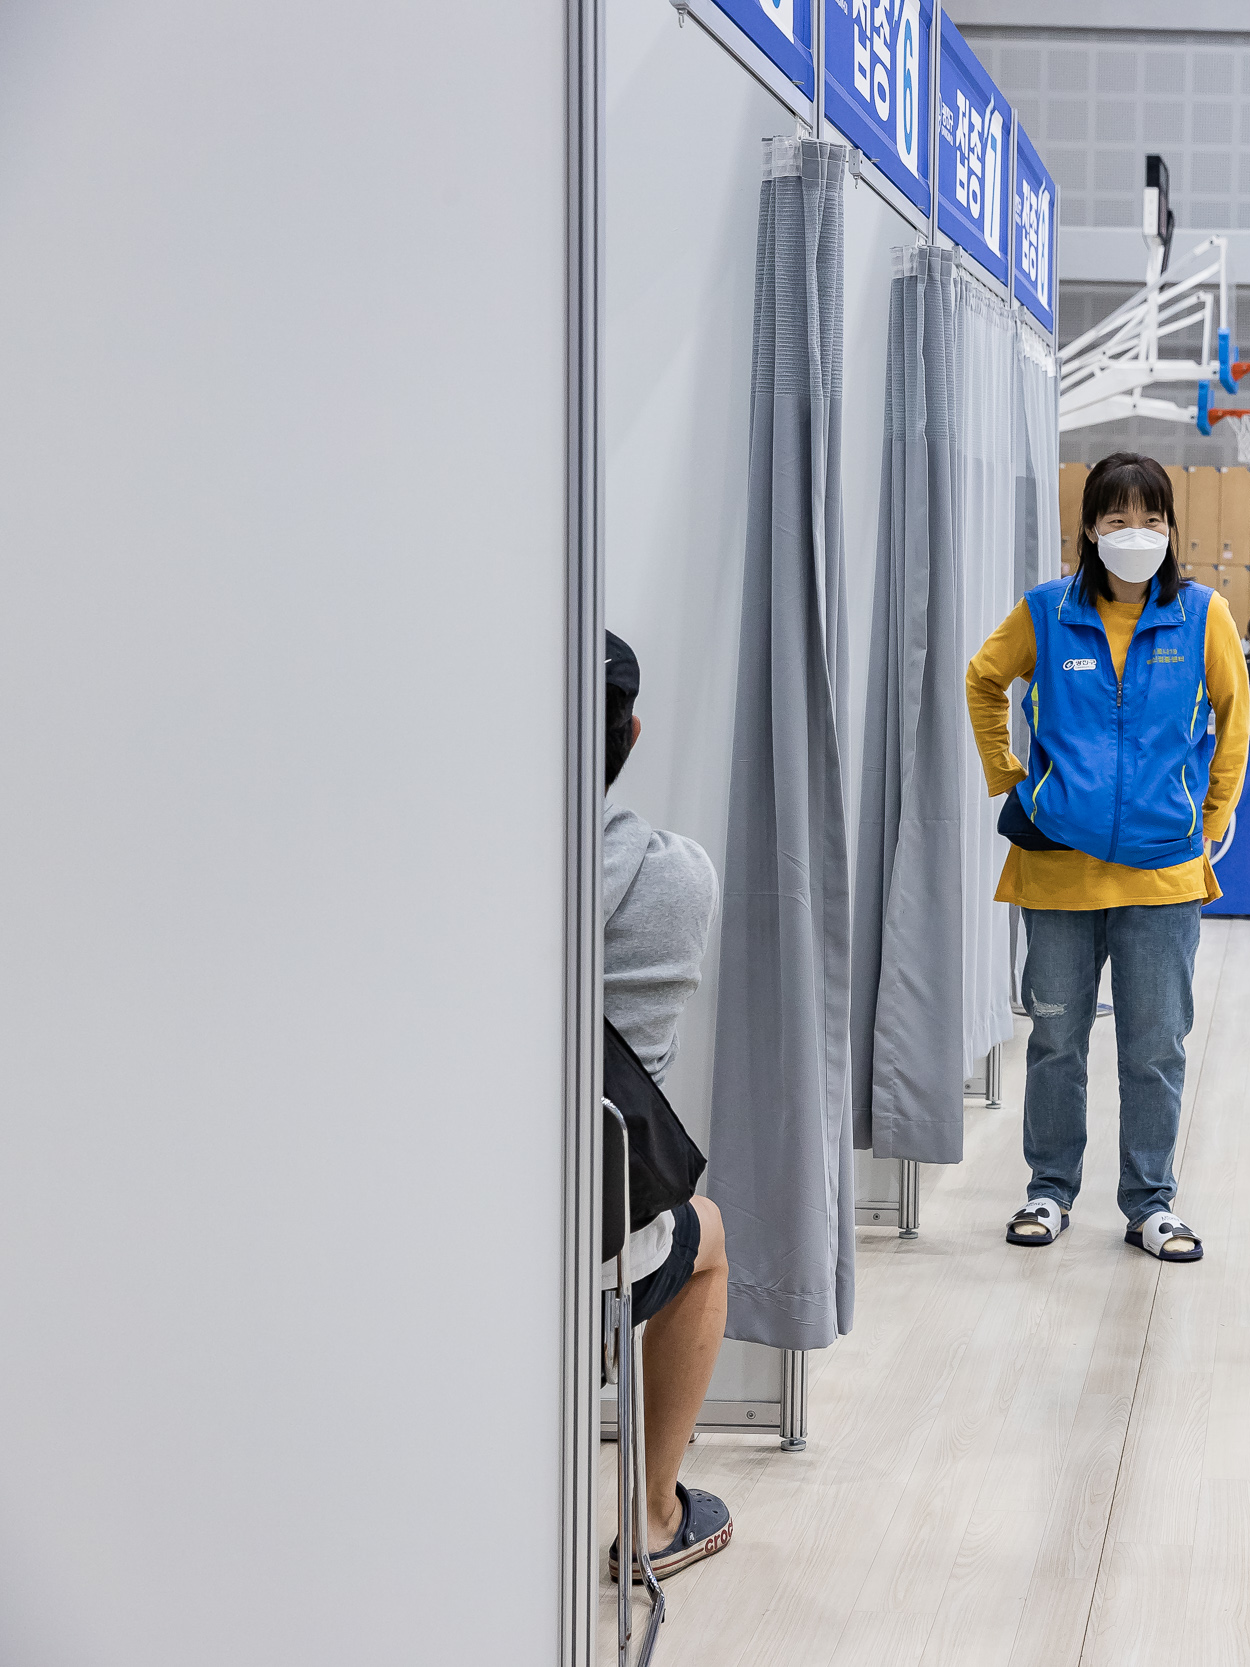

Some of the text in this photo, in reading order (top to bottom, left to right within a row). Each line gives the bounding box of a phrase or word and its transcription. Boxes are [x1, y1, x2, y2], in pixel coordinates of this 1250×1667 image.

[903, 18, 914, 156] 6
[955, 88, 998, 239] 접종 7
[1021, 178, 1038, 282] 접종
[704, 1517, 734, 1554] croc
